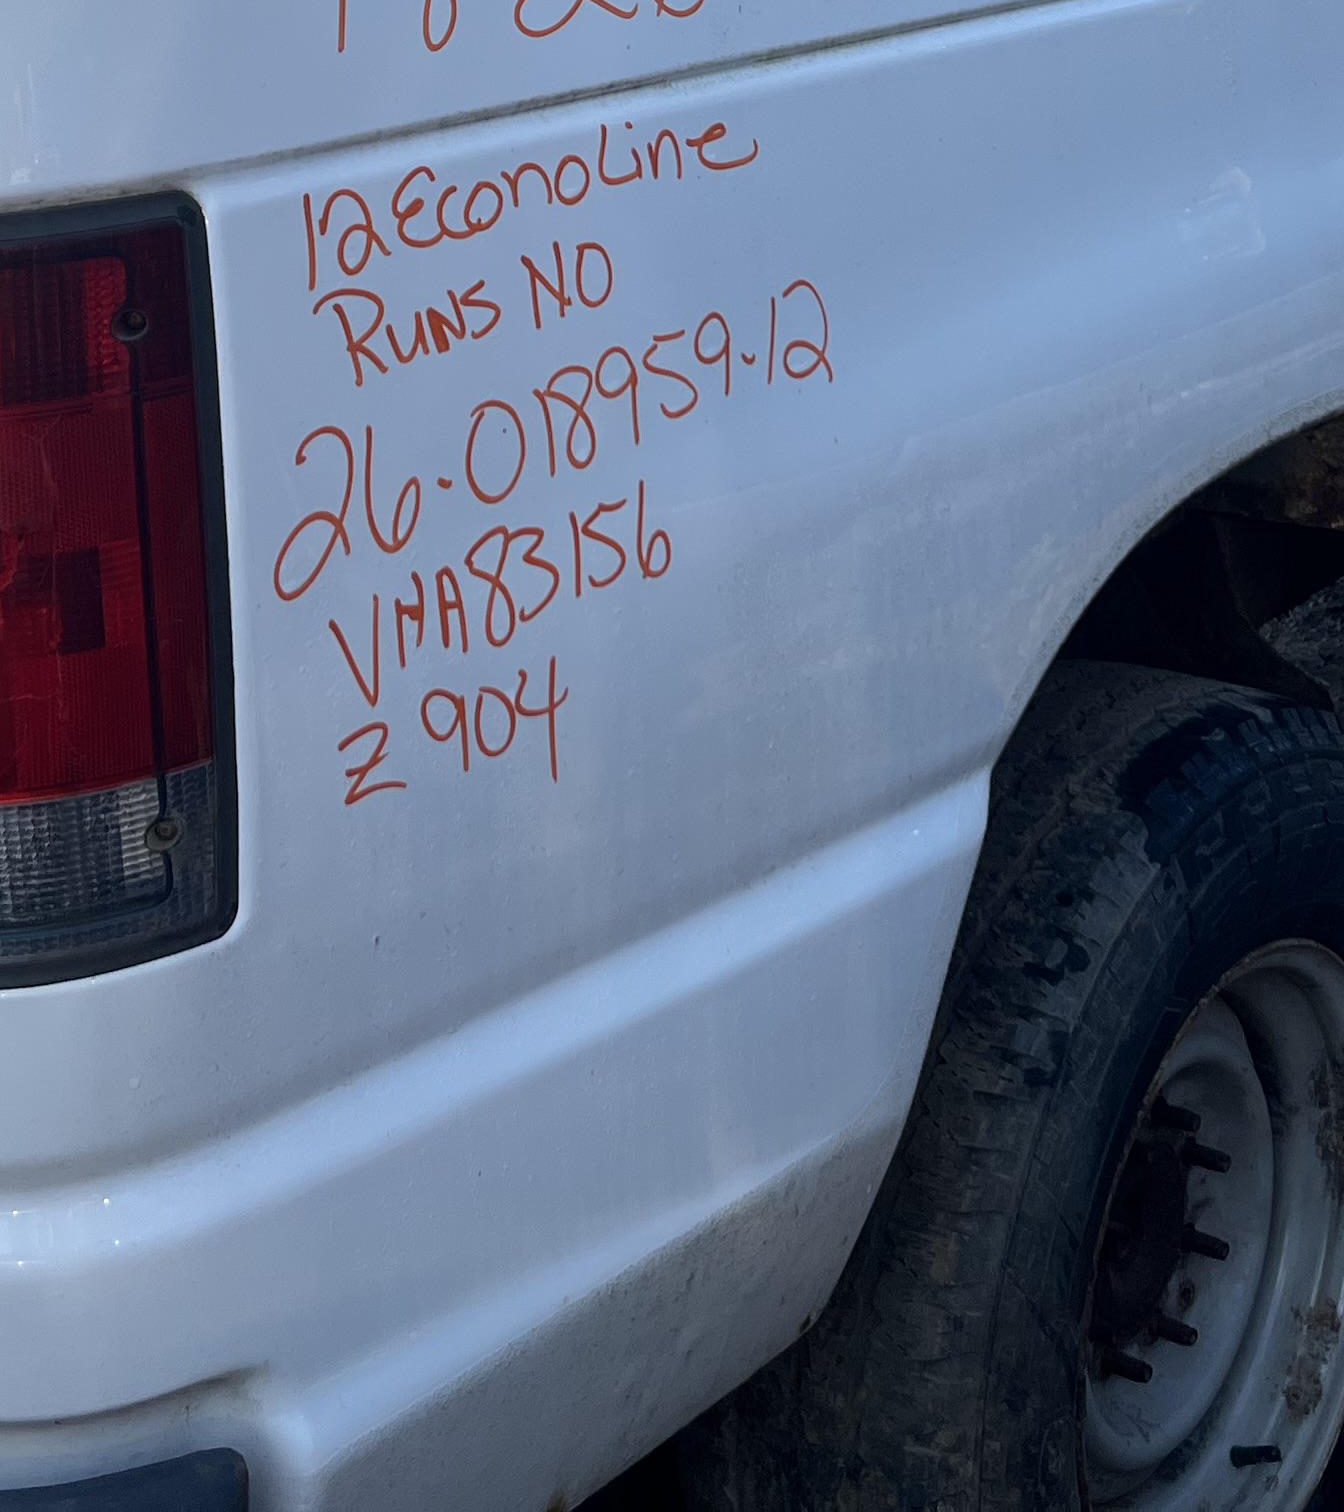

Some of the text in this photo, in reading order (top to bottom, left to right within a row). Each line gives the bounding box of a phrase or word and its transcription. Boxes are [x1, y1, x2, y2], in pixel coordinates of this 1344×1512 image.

[521, 241, 613, 330] NO
[329, 479, 671, 708] VHA83156
[420, 655, 568, 783] 904
